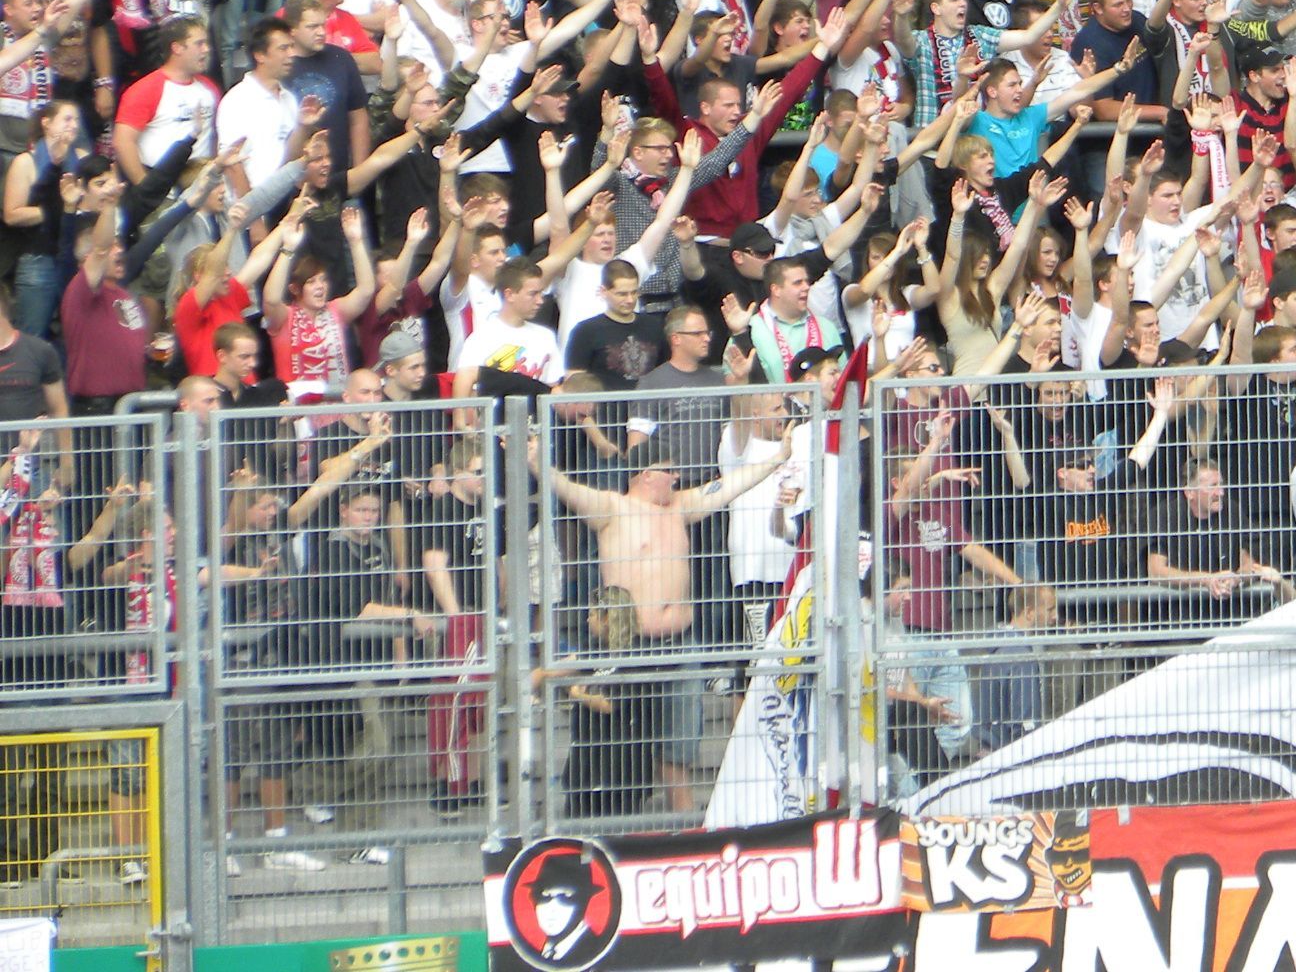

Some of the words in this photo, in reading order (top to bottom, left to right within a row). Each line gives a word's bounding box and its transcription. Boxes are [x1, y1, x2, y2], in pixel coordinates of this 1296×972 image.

[914, 818, 1035, 849] YOUNGS
[634, 843, 801, 940] equipo
[926, 844, 1033, 908] KS
